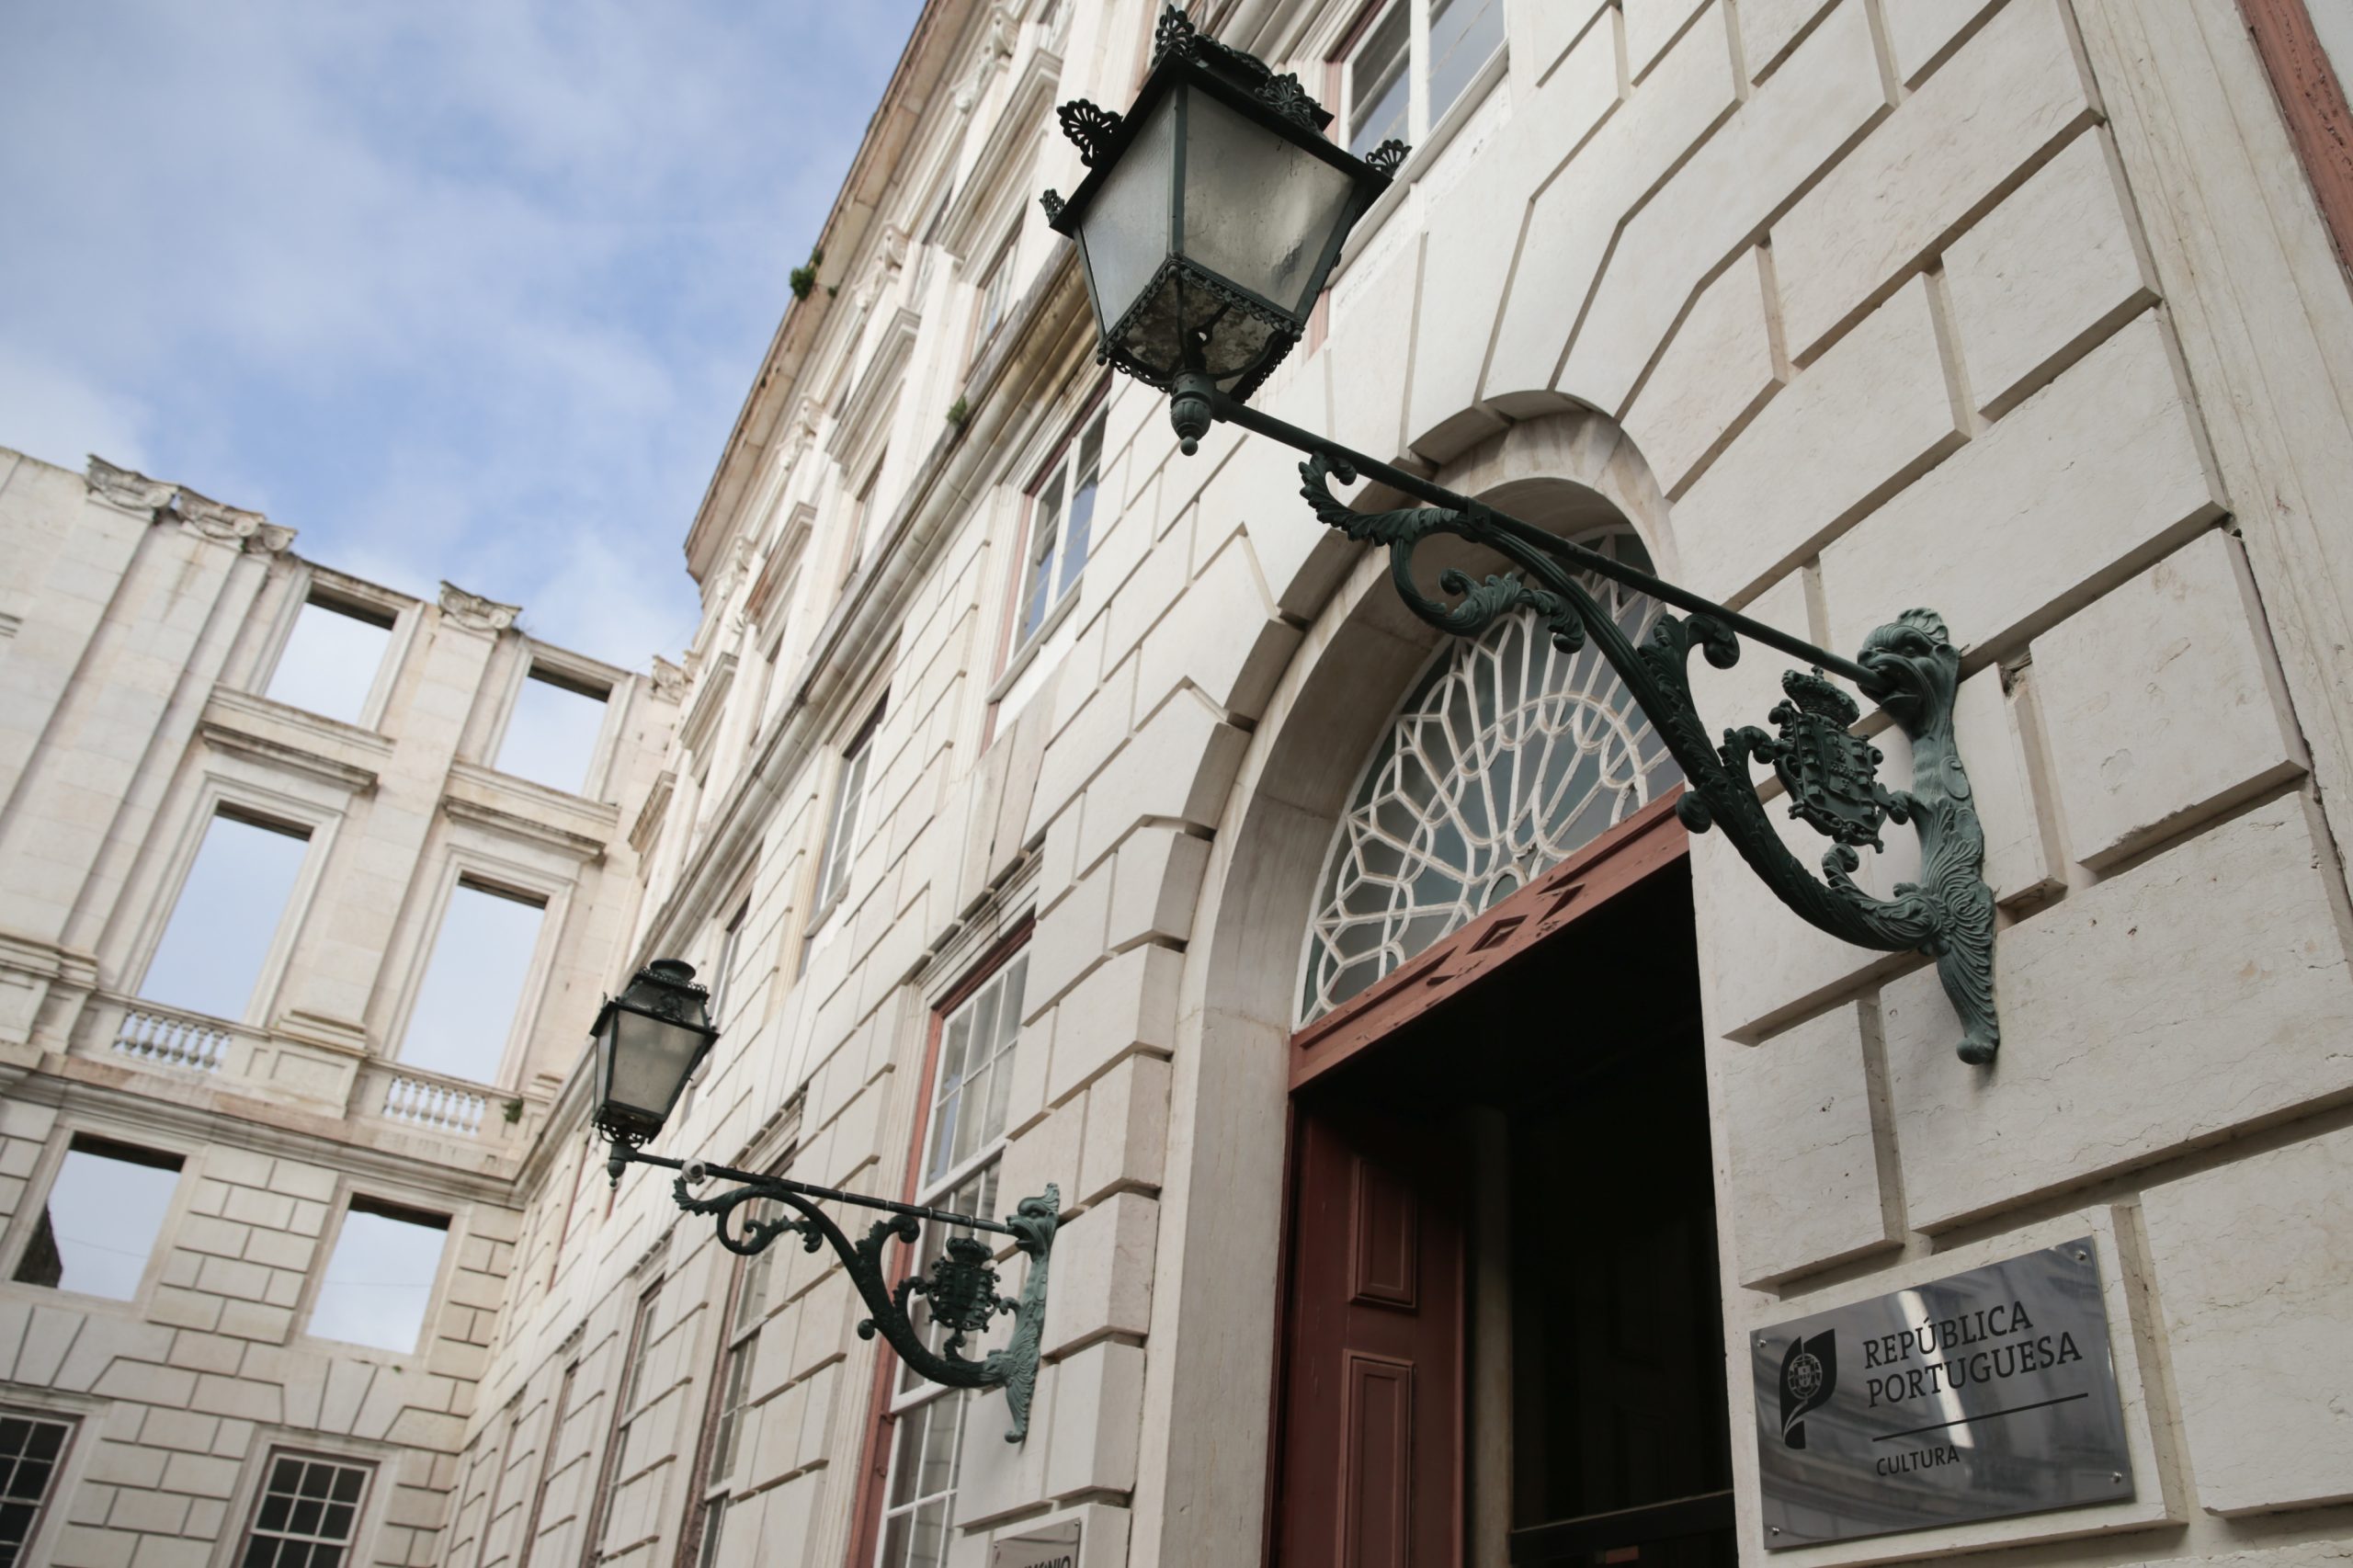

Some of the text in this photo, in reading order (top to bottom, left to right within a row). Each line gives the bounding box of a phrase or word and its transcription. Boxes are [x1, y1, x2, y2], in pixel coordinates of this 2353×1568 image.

[1863, 1301, 2033, 1369] REPÚBLICA
[1866, 1331, 2083, 1408] PORTUGUESA
[1876, 1444, 1961, 1477] CULTURA
